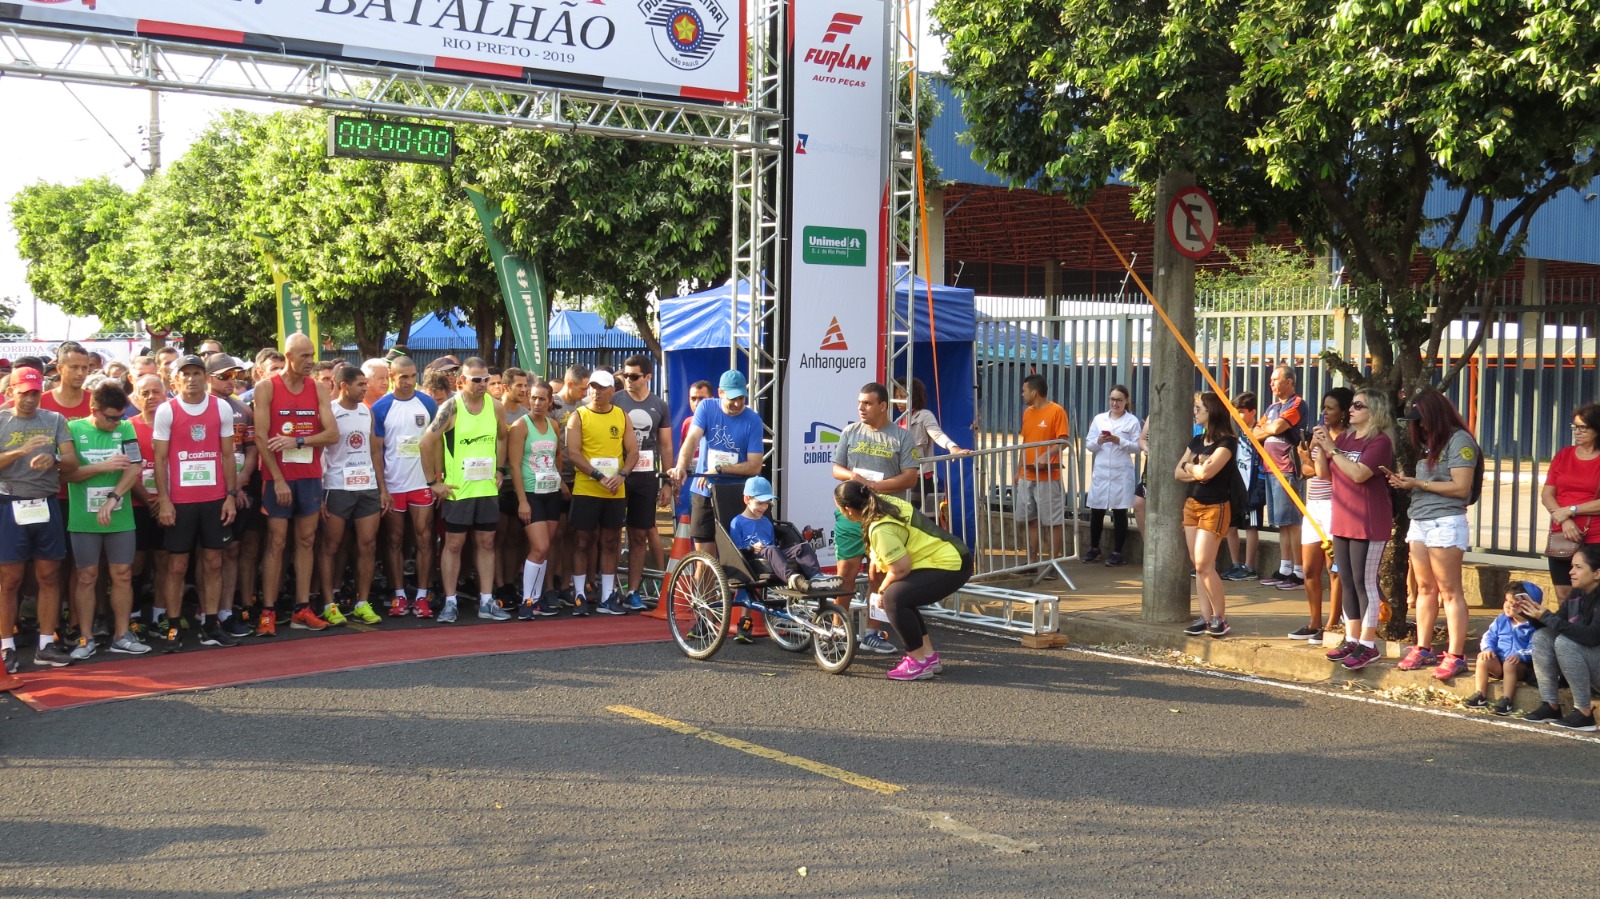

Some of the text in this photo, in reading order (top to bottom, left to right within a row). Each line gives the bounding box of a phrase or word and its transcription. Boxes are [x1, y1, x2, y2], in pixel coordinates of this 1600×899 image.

[442, 36, 472, 51] RIO
[476, 42, 531, 59] PRETO
[542, 50, 575, 64] 2019
[803, 43, 872, 73] FURLAN
[812, 74, 866, 88] AUTO PEÇAS
[338, 121, 450, 157] 00:00:00
[808, 235, 847, 247] Unimed
[521, 294, 541, 365] Unimed
[799, 352, 866, 374] Anhanguera
[803, 451, 832, 464] CIDADE
[190, 472, 204, 480] 76
[349, 477, 367, 485] 552
